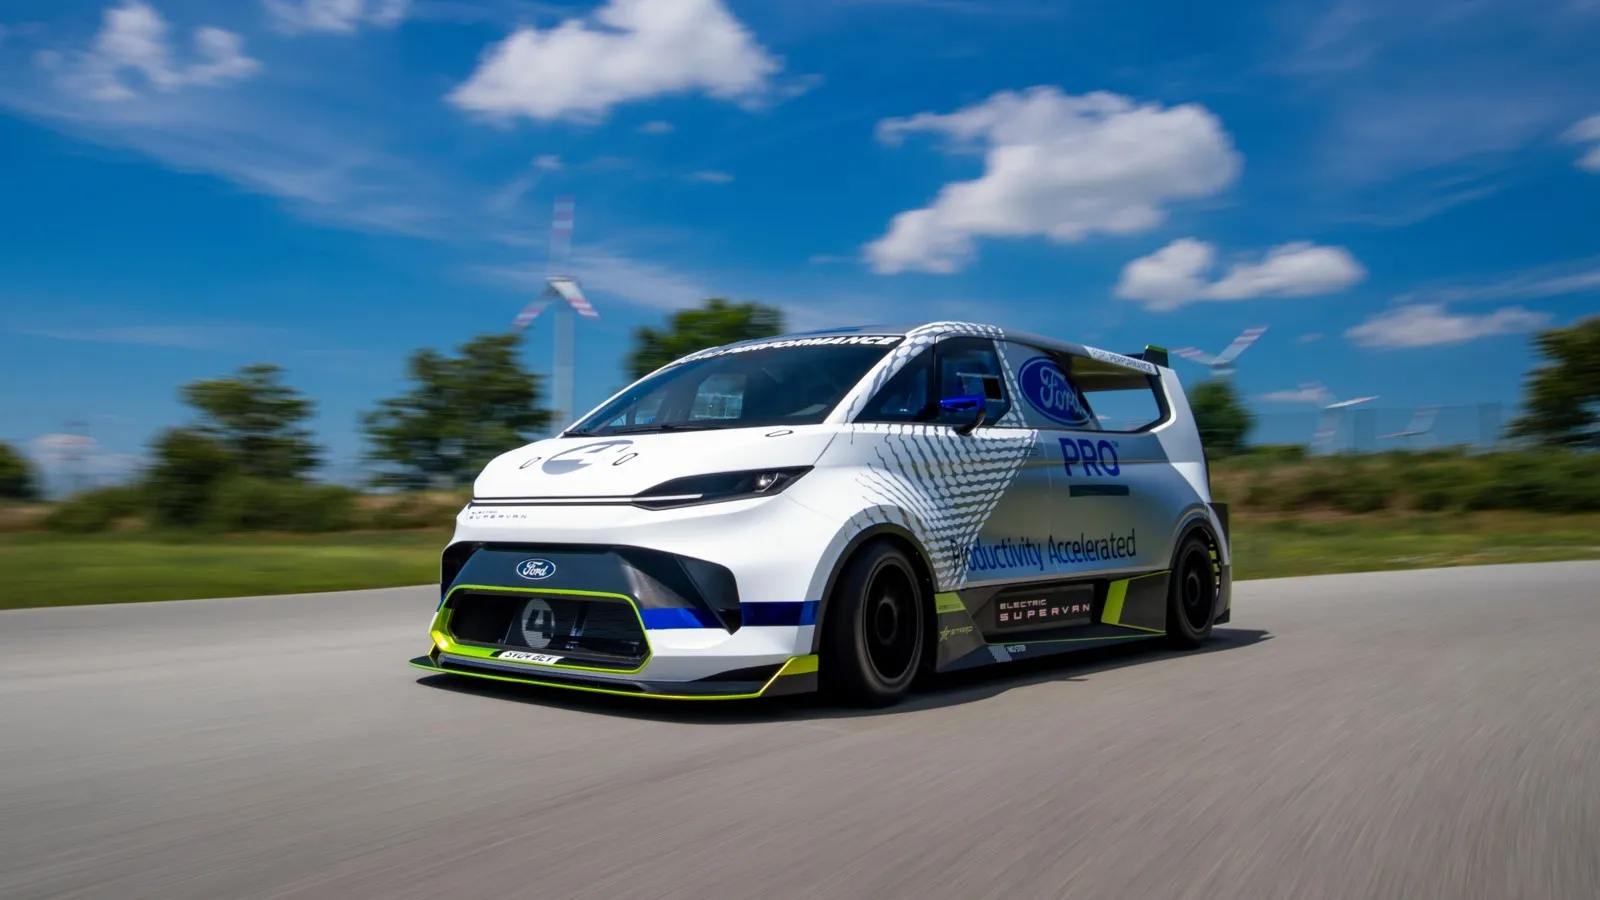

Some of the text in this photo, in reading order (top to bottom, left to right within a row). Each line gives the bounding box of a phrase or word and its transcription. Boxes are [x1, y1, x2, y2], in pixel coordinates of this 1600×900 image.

[1058, 438, 1120, 476] PRO
[950, 528, 1137, 571] Productivity Accelerated
[522, 561, 549, 577] Ford
[1000, 599, 1047, 610] ELECTRIC
[1000, 604, 1091, 621] SUPERVAN
[525, 608, 556, 639] 4
